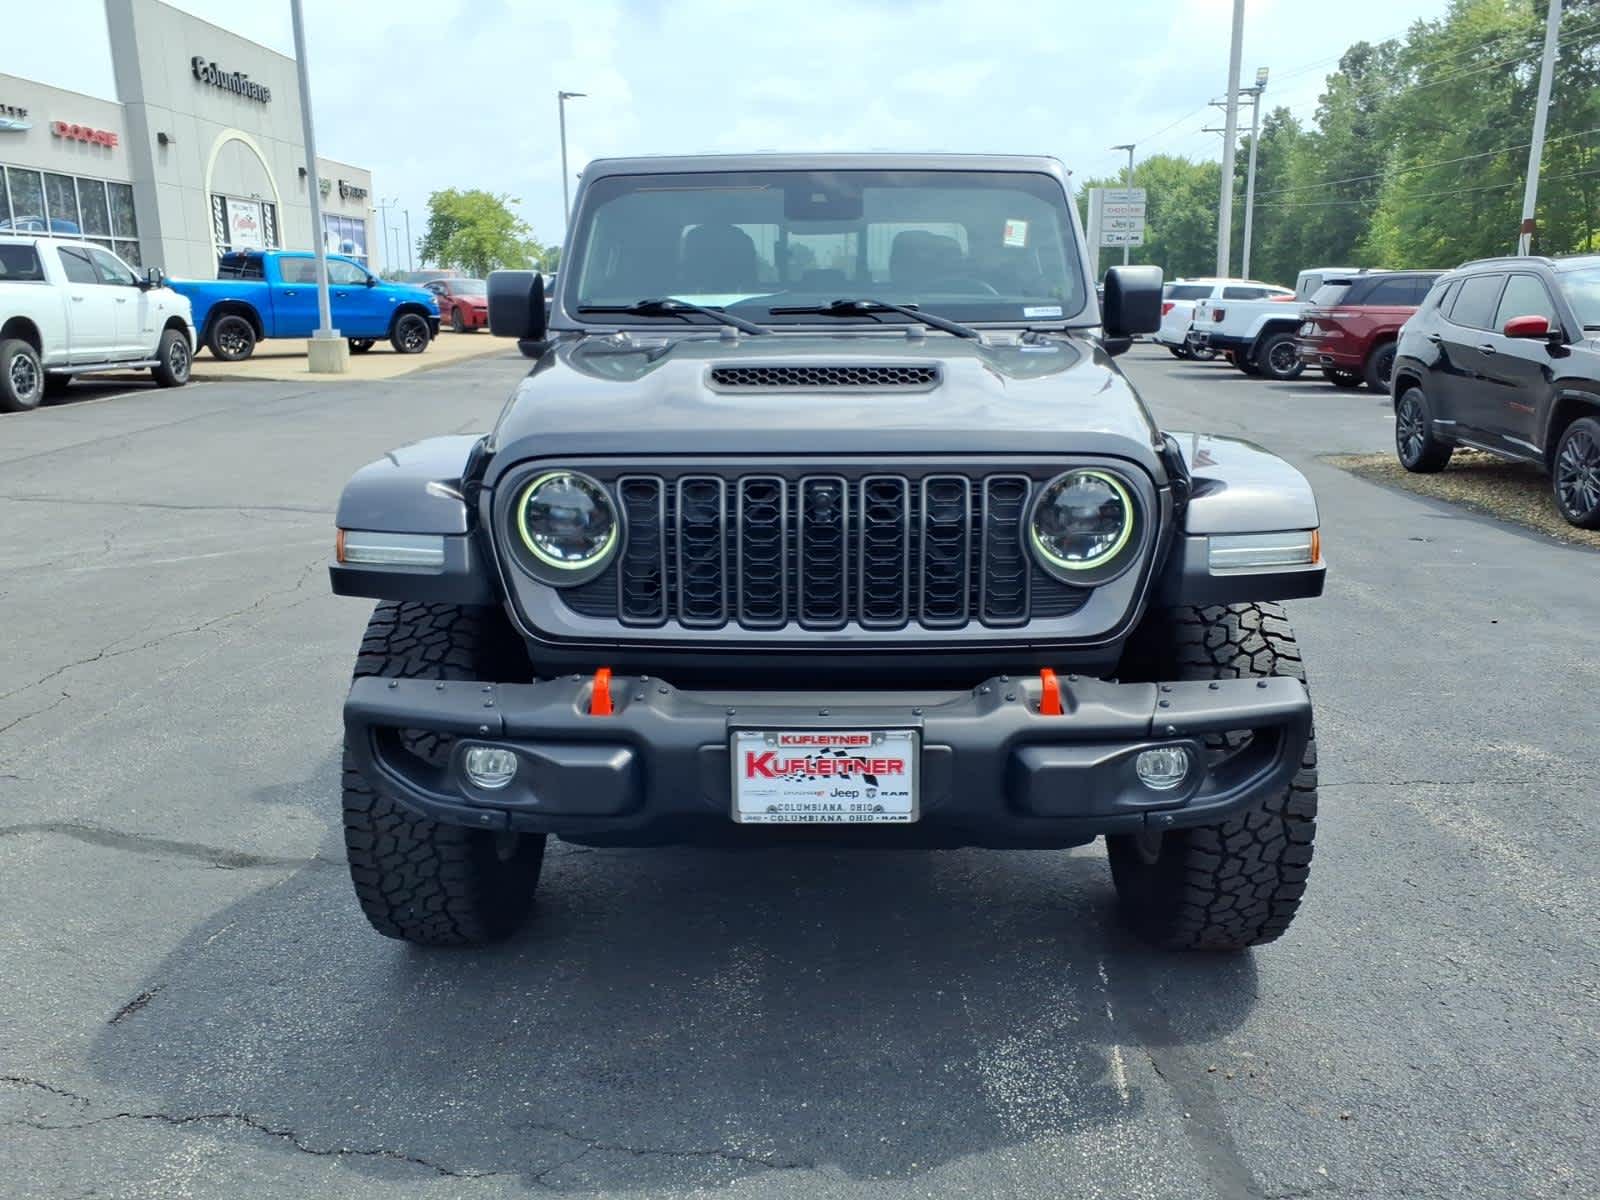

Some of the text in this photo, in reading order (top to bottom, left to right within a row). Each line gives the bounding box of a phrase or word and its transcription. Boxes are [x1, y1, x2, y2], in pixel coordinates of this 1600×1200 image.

[191, 55, 272, 104] Columbiana
[50, 120, 118, 149] DODGE
[781, 735, 870, 745] KUFLEITNER
[830, 787, 860, 799] Jeep
[849, 803, 873, 812] OHIO
[848, 814, 874, 822] OHIO
